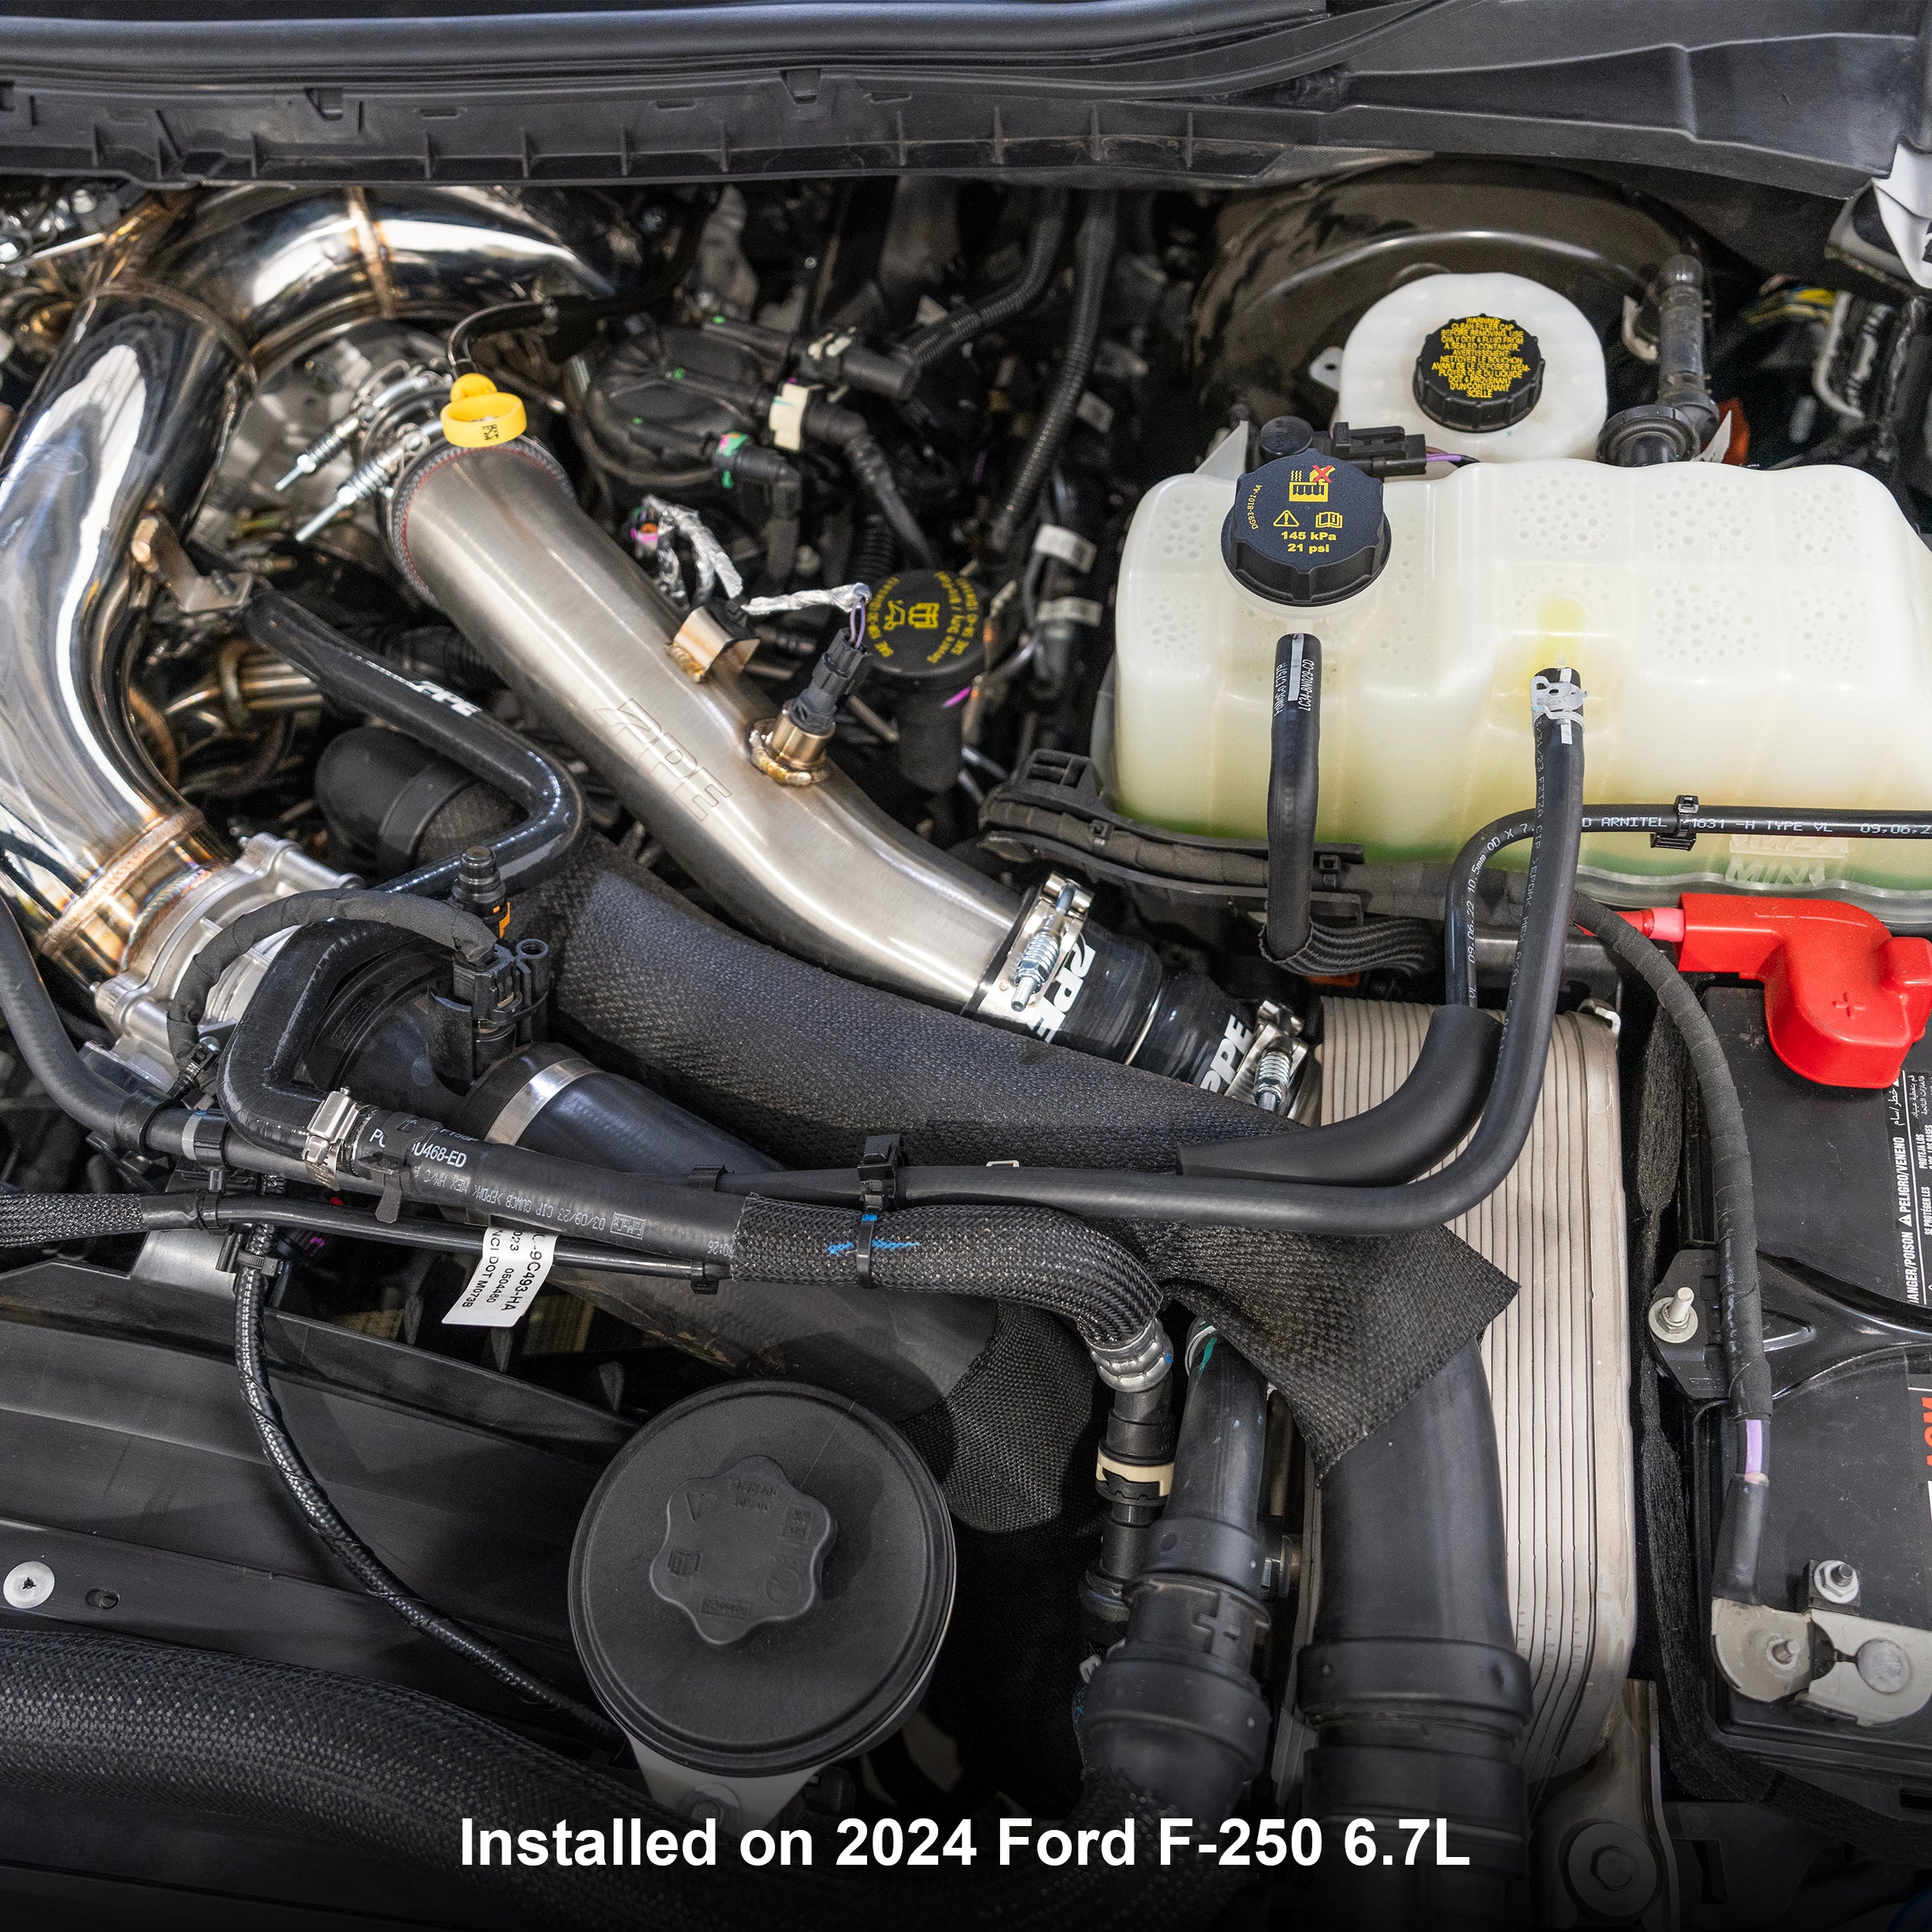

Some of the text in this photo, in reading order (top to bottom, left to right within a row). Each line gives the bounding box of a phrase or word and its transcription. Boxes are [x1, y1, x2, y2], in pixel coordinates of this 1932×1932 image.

[1467, 383, 1510, 392] CONTENANT
[1469, 376, 1512, 385] PROVENANT
[1247, 485, 1263, 529] DG93-8101-AA
[1281, 532, 1337, 541] 145 kPa
[1287, 543, 1330, 554] 21 psi
[1298, 659, 1315, 711] LC34-8N029-CD
[1600, 816, 1668, 828] ARNITEL
[1766, 821, 1804, 832] TYPE
[1814, 822, 1833, 832] VL
[1467, 854, 1487, 893] 10.5mm
[1915, 1133, 1928, 1169] PROTEJA LOS
[1893, 1136, 1911, 1213] PELIGRO/VENENO
[1921, 1186, 1931, 1197] LES
[1920, 1198, 1932, 1227] PROTÉGER
[481, 1256, 499, 1279] DOT
[501, 1232, 546, 1311] C-9C493-HA
[461, 1280, 488, 1308] M073B
